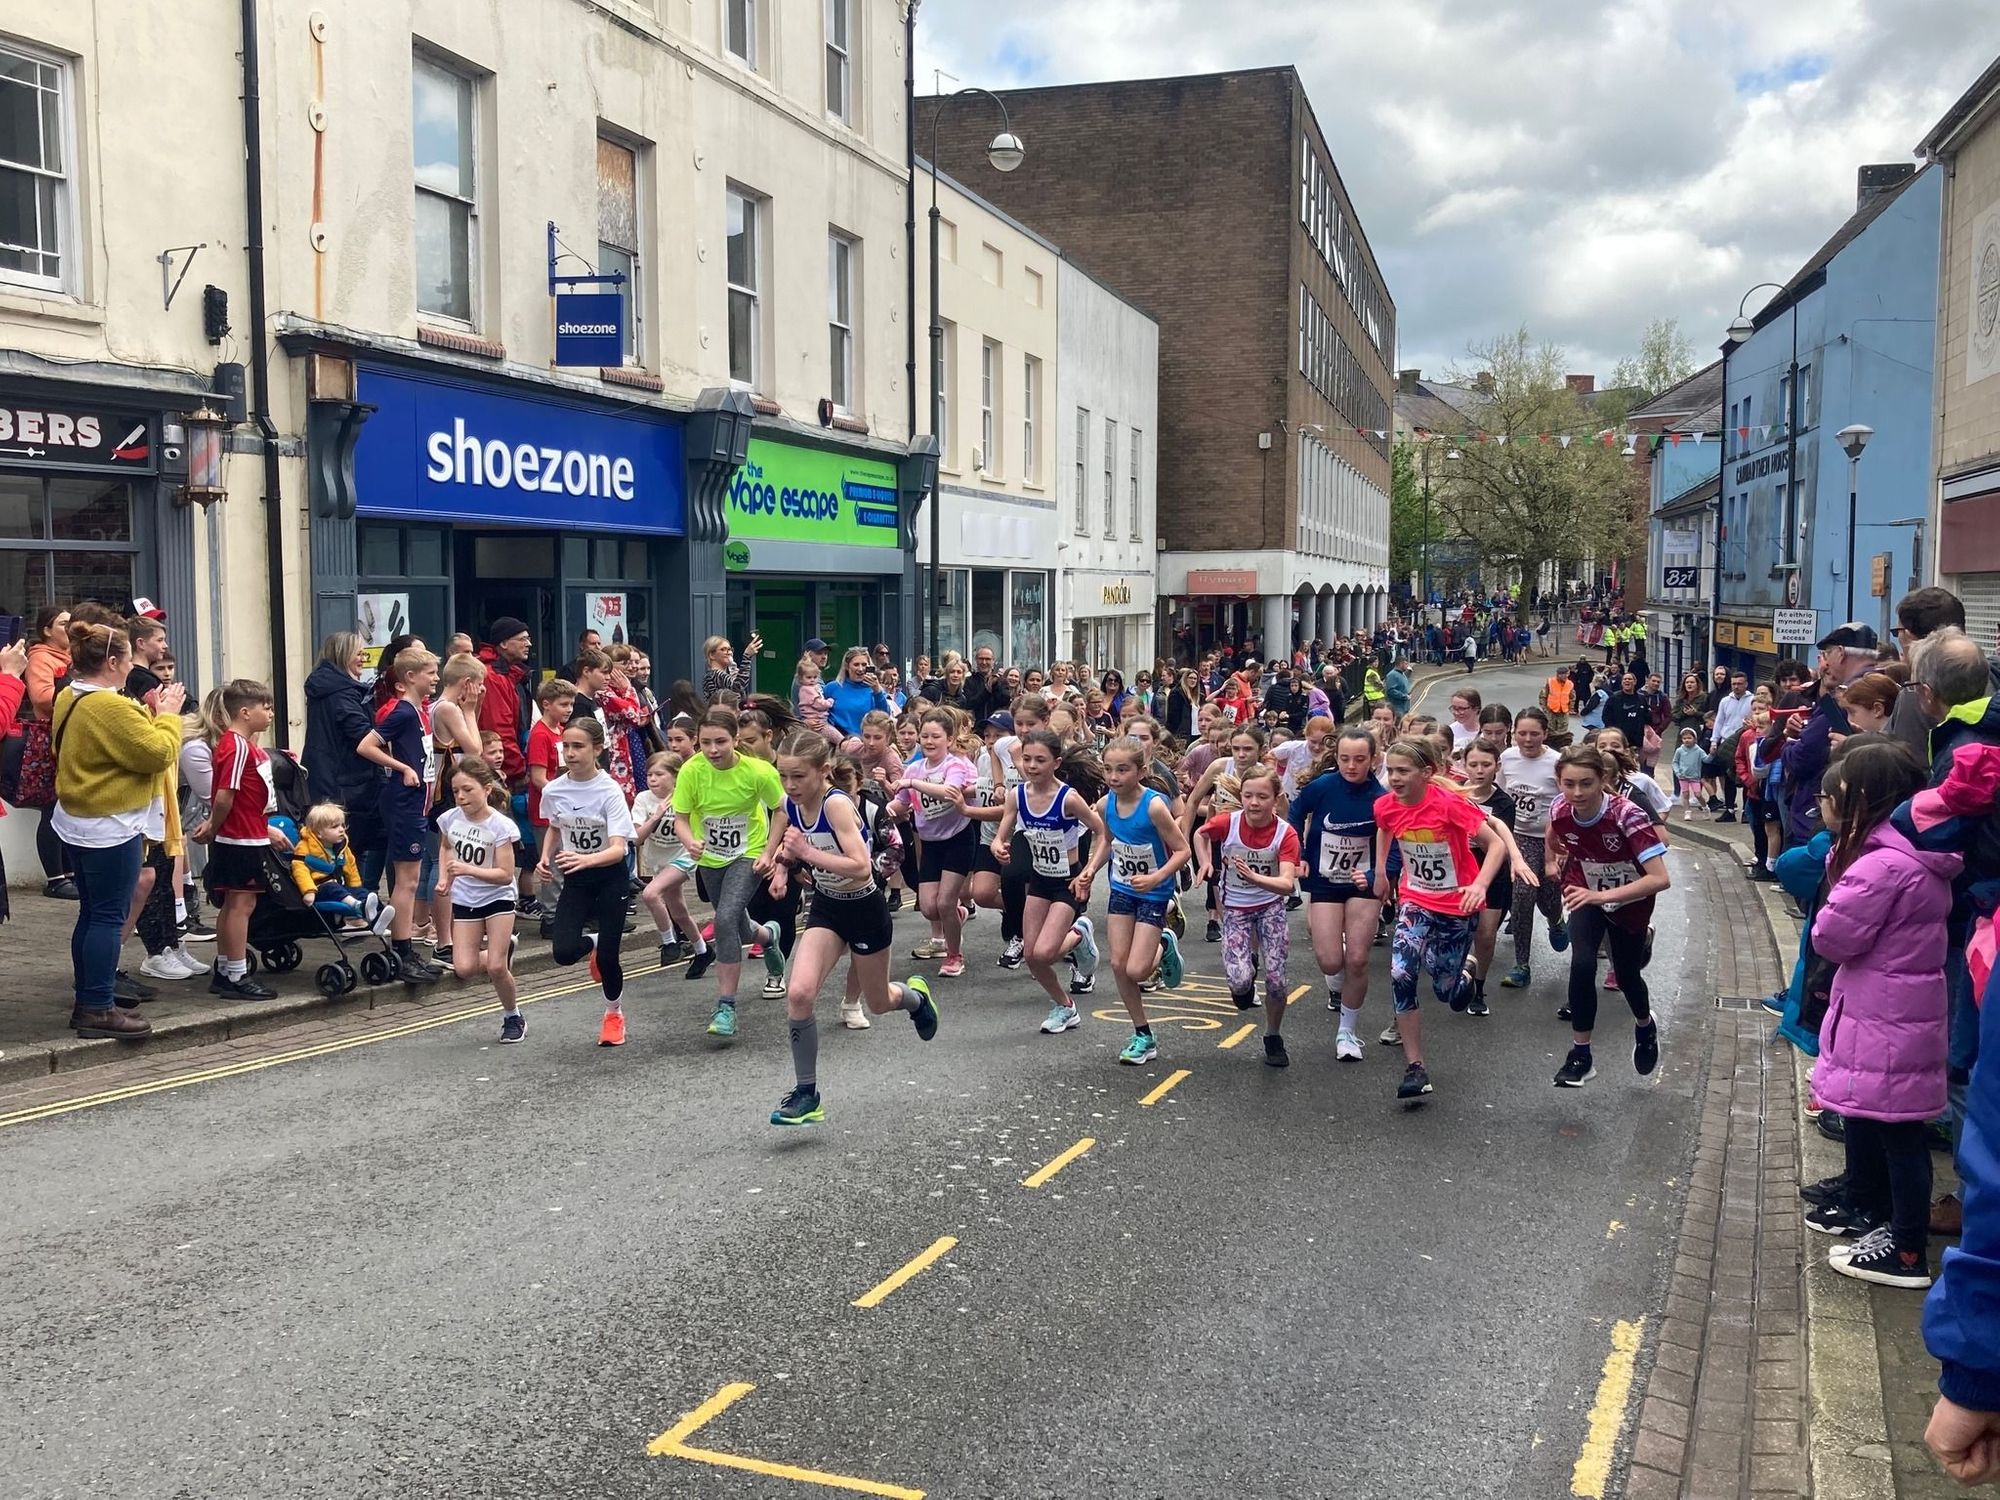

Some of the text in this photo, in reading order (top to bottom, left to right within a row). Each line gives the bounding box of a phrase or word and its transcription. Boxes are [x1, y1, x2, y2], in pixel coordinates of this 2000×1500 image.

[559, 322, 616, 334] shoezone
[426, 416, 635, 500] shoezone
[747, 460, 763, 478] the
[729, 471, 839, 521] Vape escape
[1666, 569, 1695, 586] B27
[1103, 580, 1131, 605] PANDORA
[1776, 627, 1800, 635] Except
[569, 829, 602, 850] 465
[708, 828, 741, 848] 550
[454, 839, 486, 866] 400
[1032, 844, 1061, 865] 440
[1328, 849, 1364, 871] 767
[1118, 857, 1149, 877] 399
[1409, 857, 1446, 881] 265
